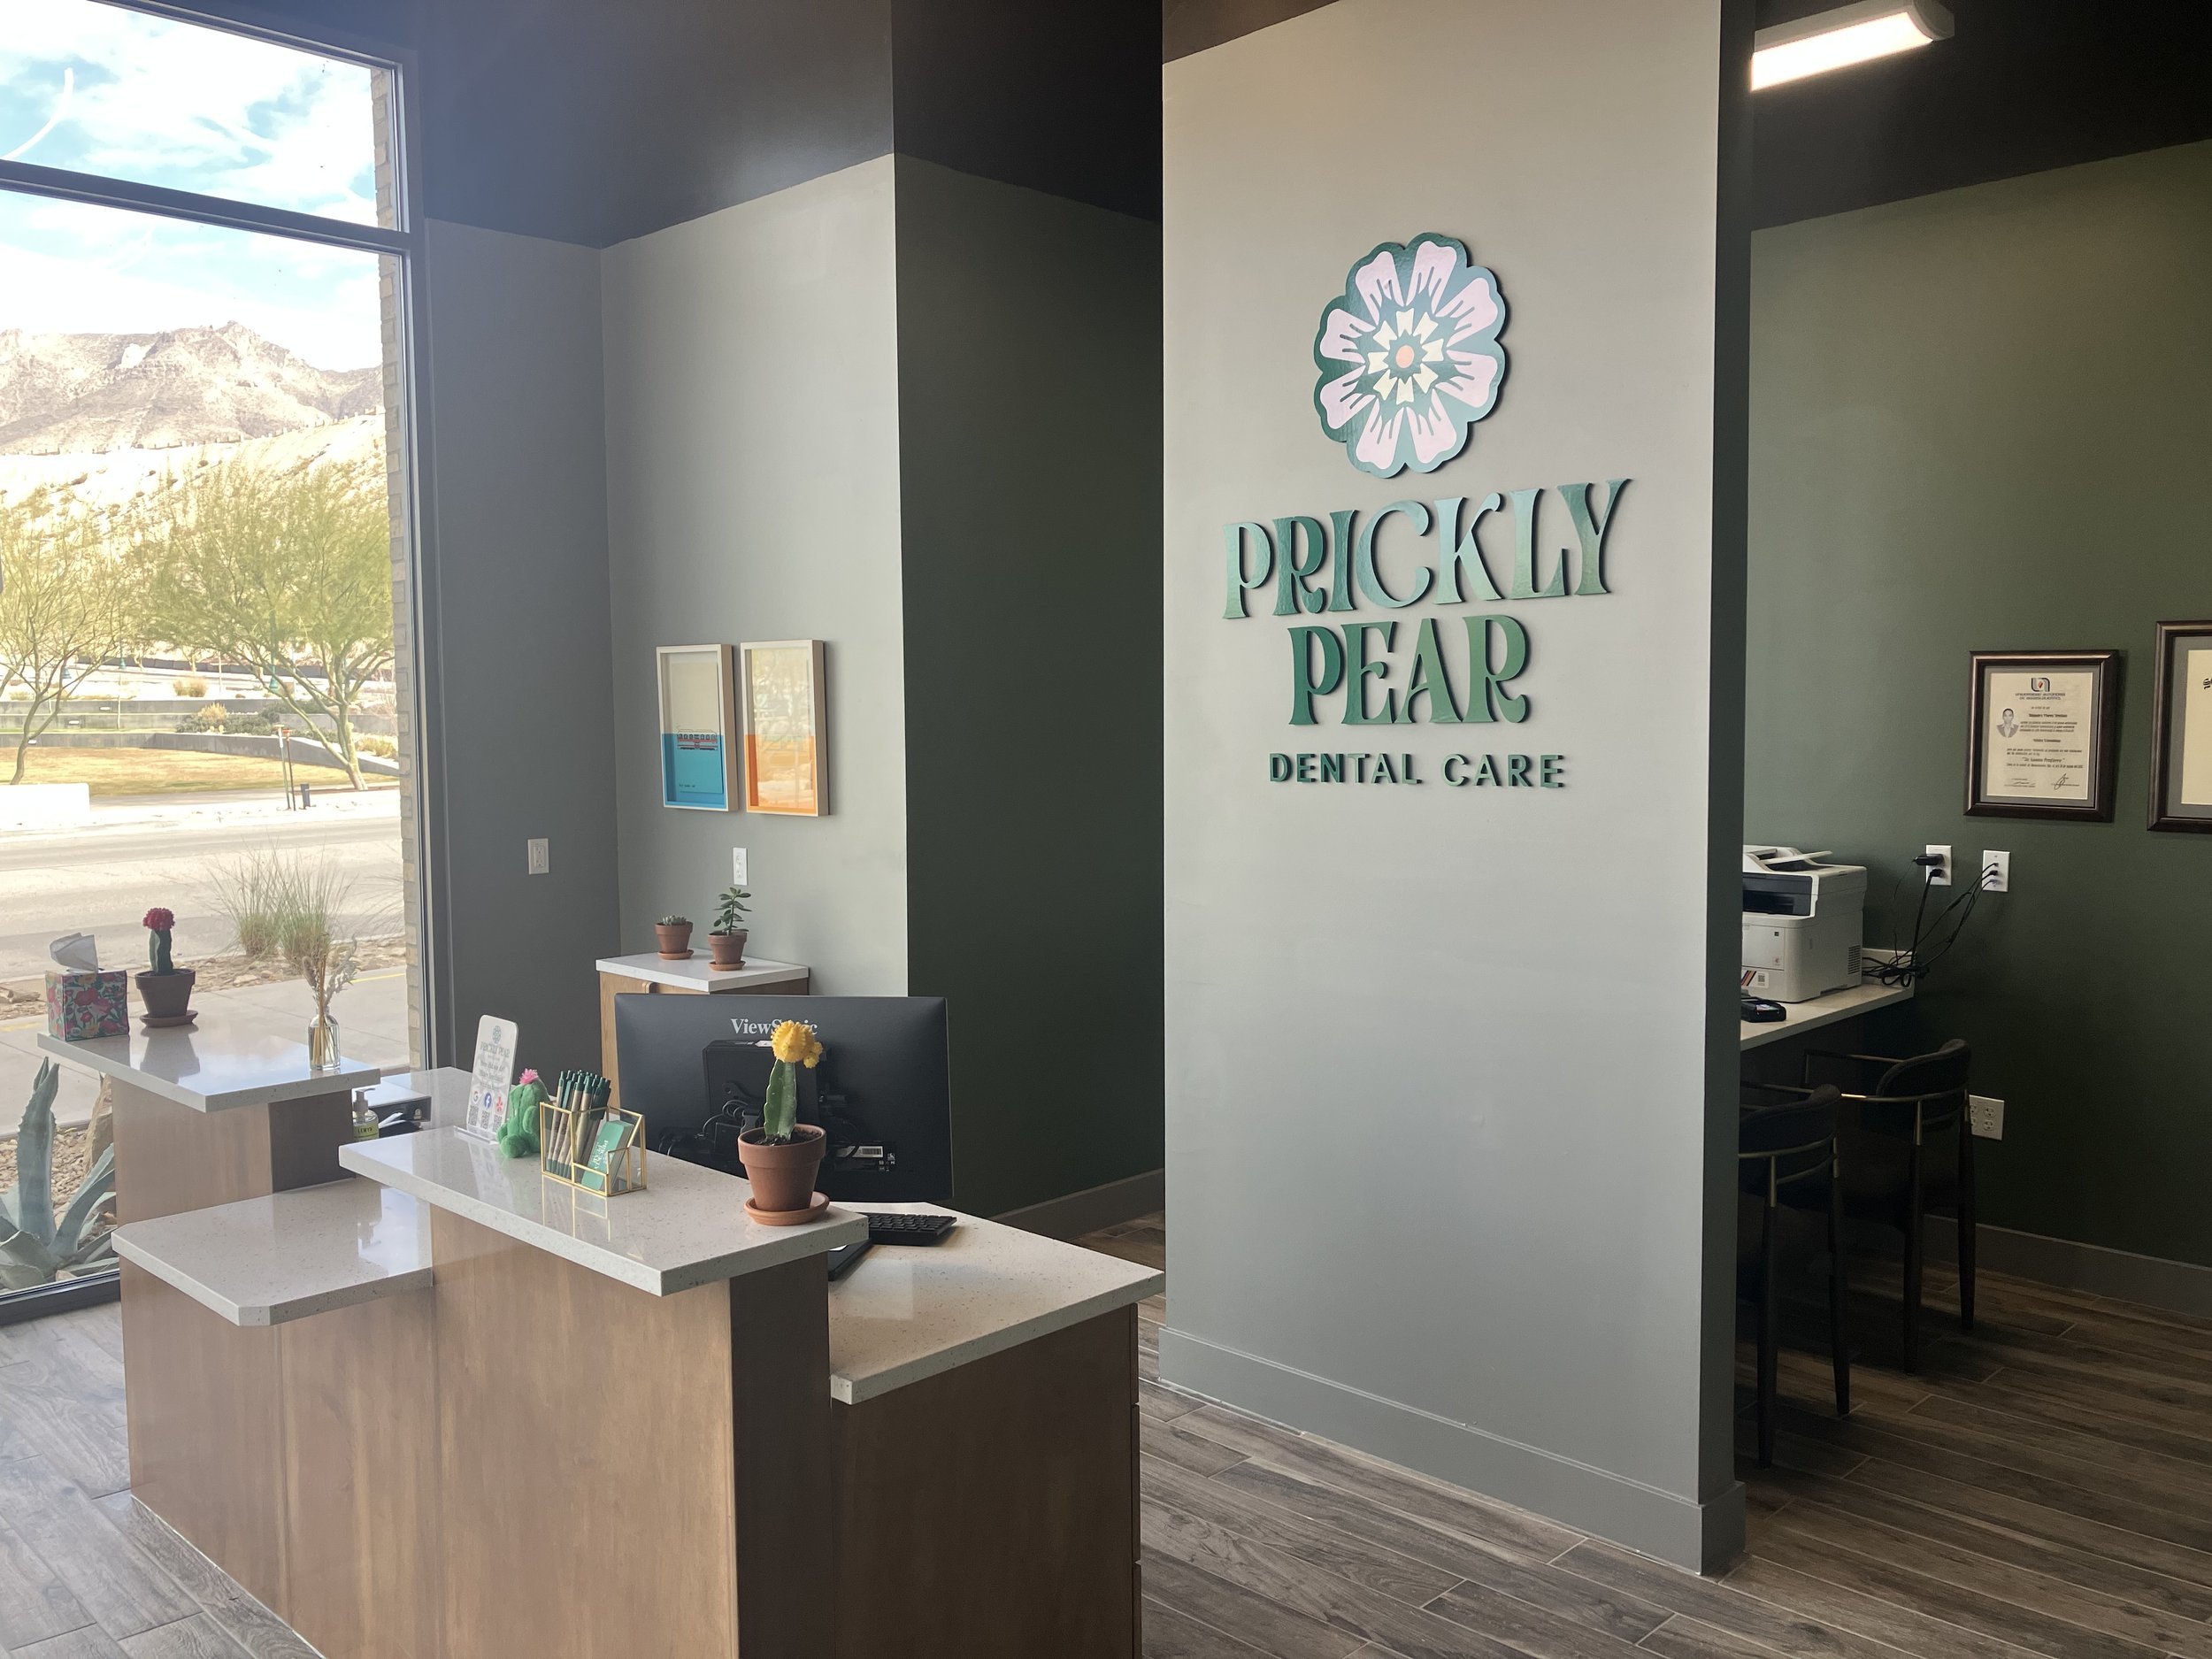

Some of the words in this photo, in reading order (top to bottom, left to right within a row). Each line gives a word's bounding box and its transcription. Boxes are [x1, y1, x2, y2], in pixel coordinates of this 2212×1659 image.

[1223, 478, 1633, 618] PRICKLY
[1287, 614, 1531, 725] PEAR
[1269, 753, 1423, 785] DENTAL
[1440, 753, 1565, 788] CARE
[730, 1018, 818, 1035] ViewSc
